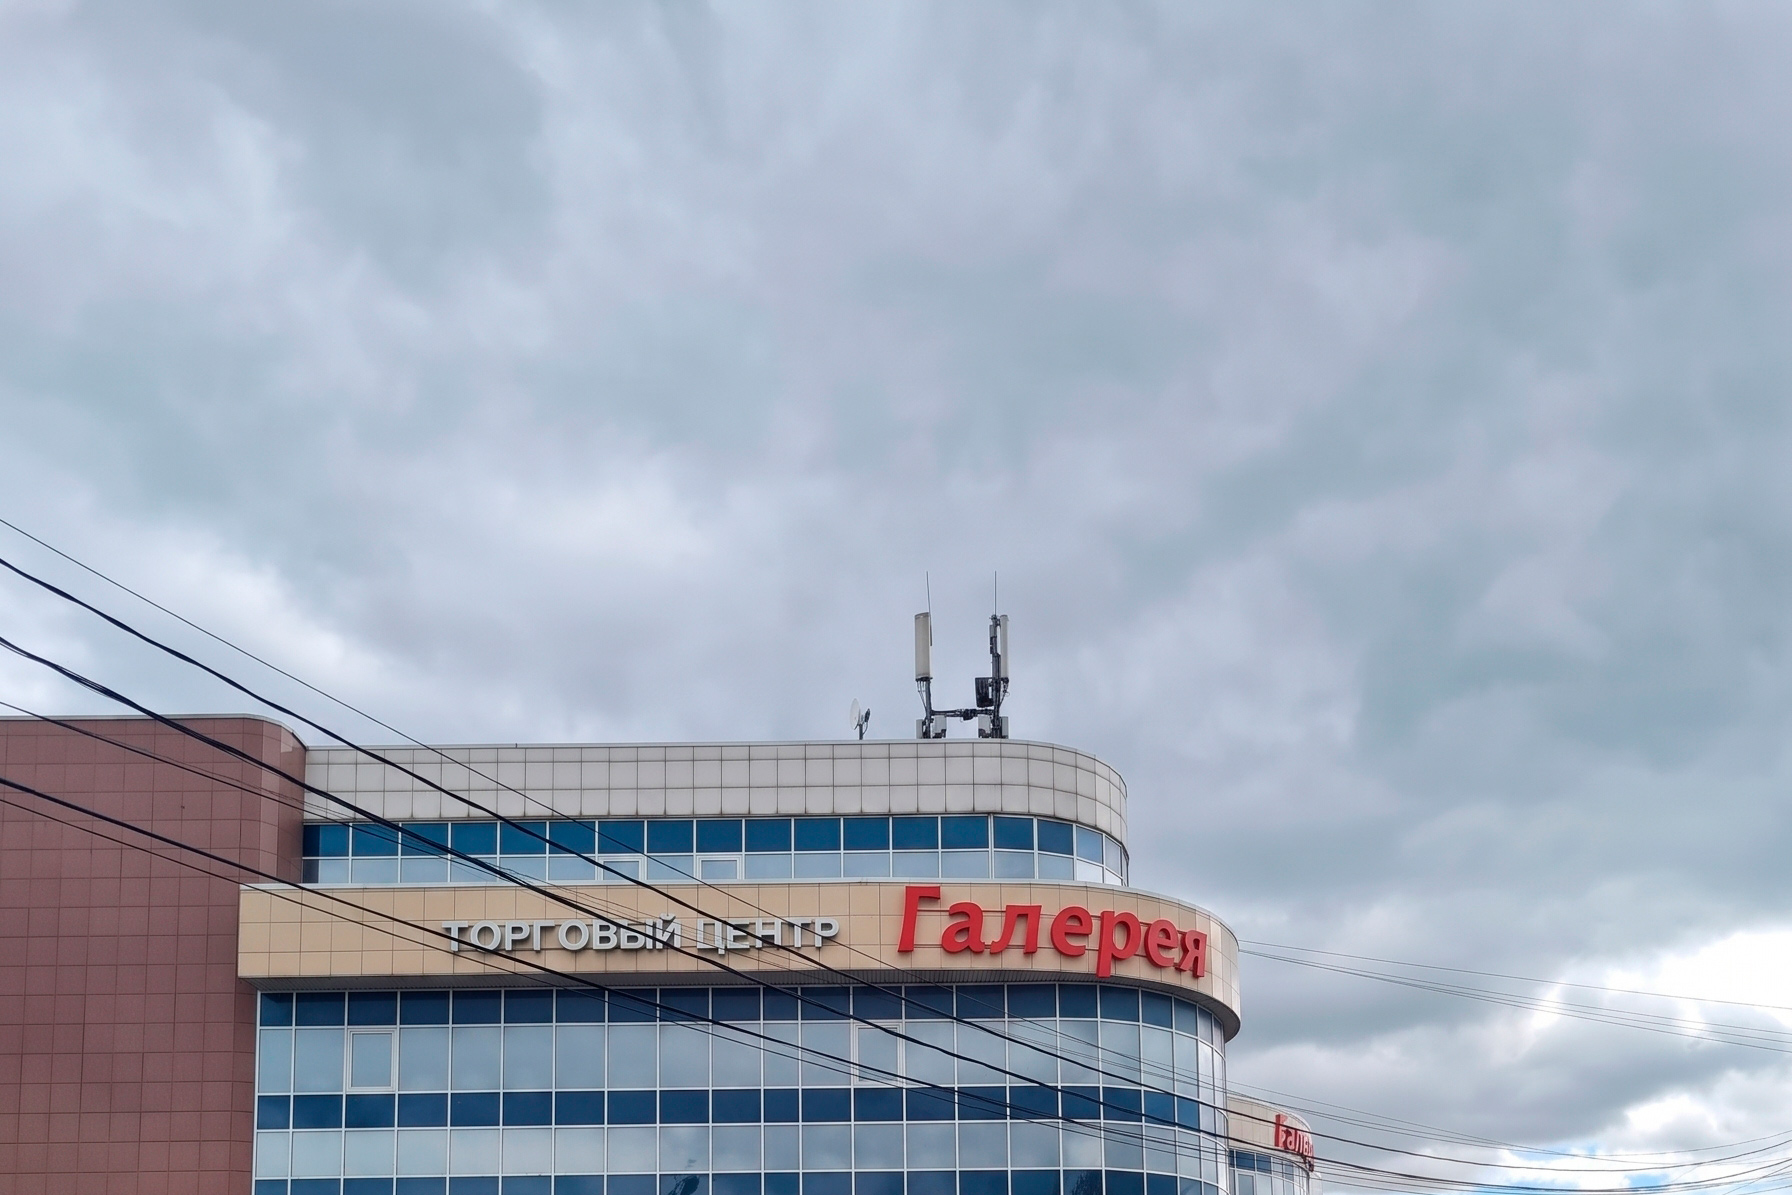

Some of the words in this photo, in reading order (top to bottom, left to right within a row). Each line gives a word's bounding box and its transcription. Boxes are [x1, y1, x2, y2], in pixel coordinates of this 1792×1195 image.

[441, 912, 682, 953] ТОРГОВЫЙ
[696, 916, 840, 955] ЦЕНТР
[897, 885, 1207, 978] Галерея
